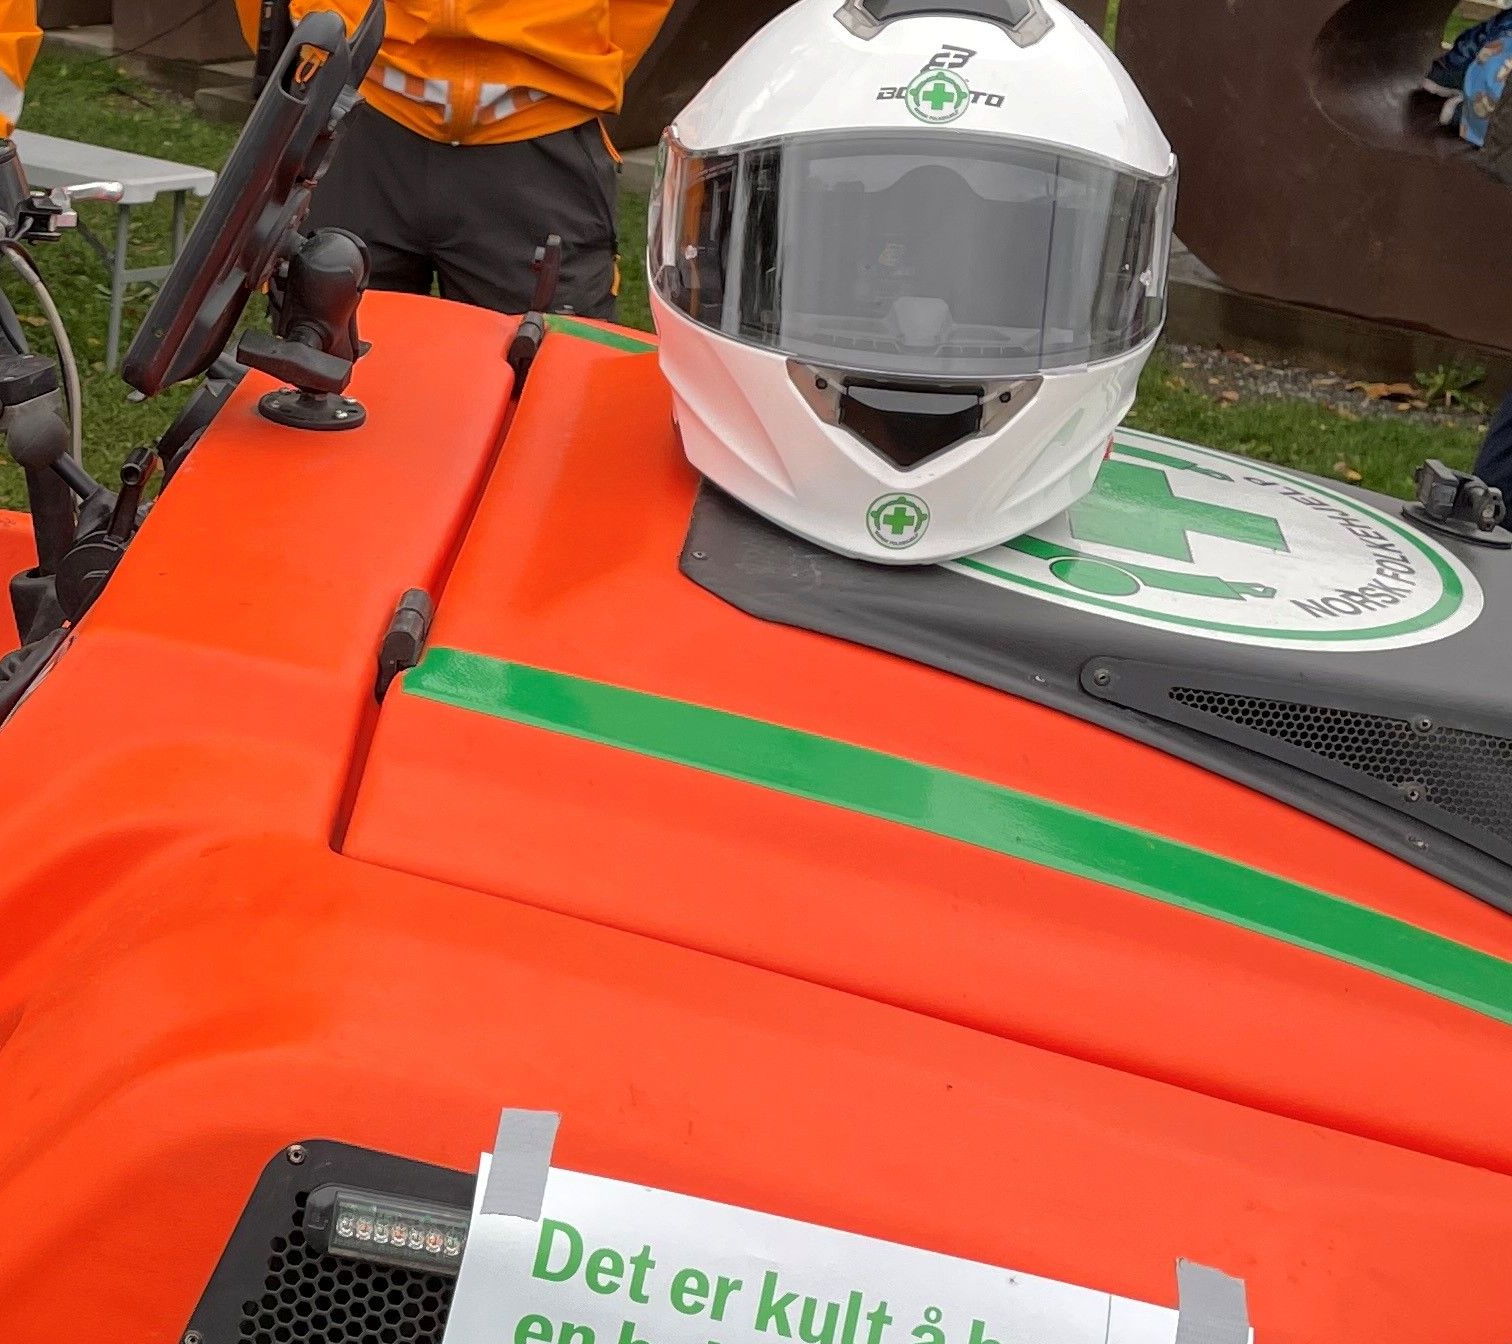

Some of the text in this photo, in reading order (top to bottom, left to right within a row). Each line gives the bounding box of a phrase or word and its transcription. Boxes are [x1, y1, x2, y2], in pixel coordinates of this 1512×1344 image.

[1243, 476, 1416, 618] NORSK FOLKEHJELP
[531, 1217, 656, 1304] Det
[669, 1267, 742, 1322] er
